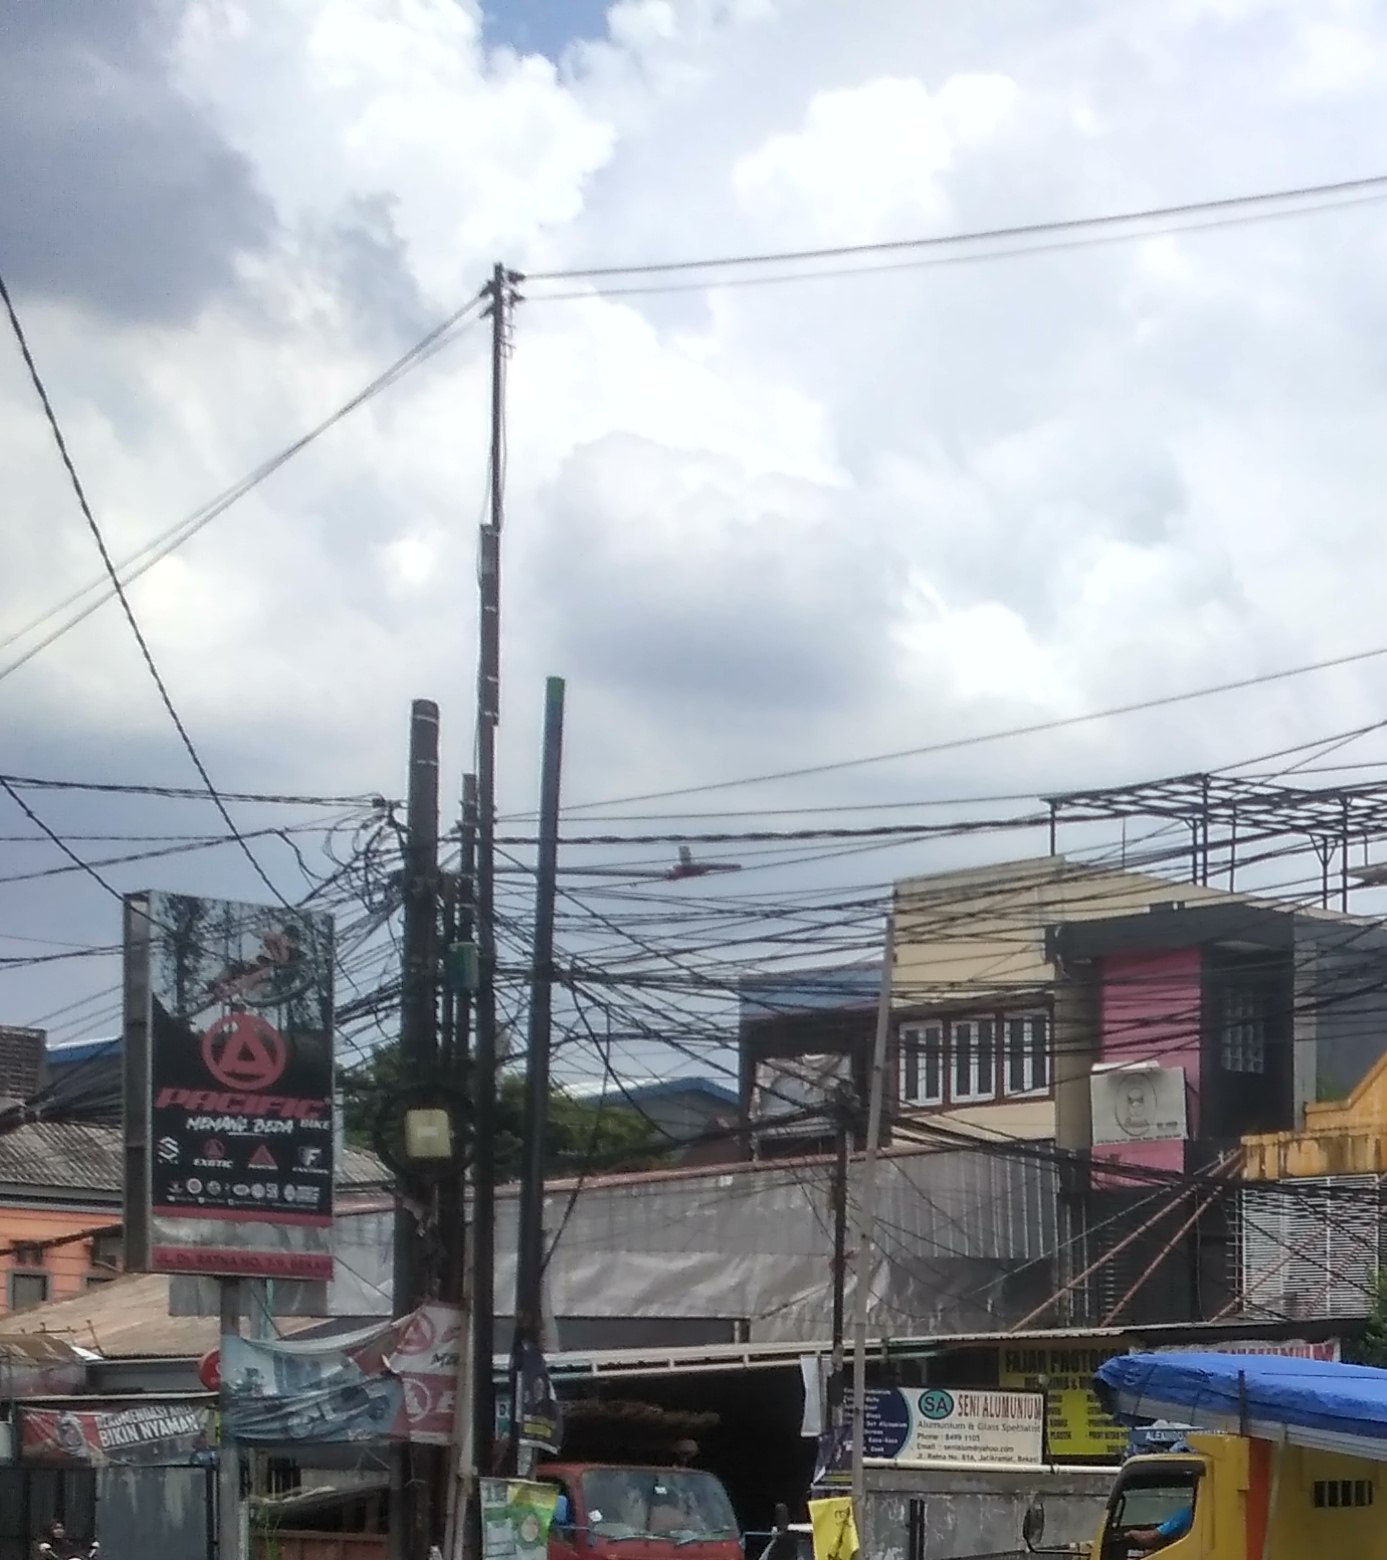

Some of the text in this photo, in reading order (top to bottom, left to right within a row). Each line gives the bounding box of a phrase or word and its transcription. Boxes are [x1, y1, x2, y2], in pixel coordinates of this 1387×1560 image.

[154, 1087, 326, 1119] PACIFIC
[252, 1118, 295, 1134] BEDA
[300, 1119, 331, 1130] BIKE
[193, 1158, 234, 1169] EXOTIC
[924, 1396, 949, 1413] SA
[957, 1394, 1042, 1420] SENI ALUMUNIUM
[100, 1414, 200, 1447] BIKIN NYAMAN
[977, 1422, 999, 1432] Glass
[917, 1432, 939, 1440] Phone
